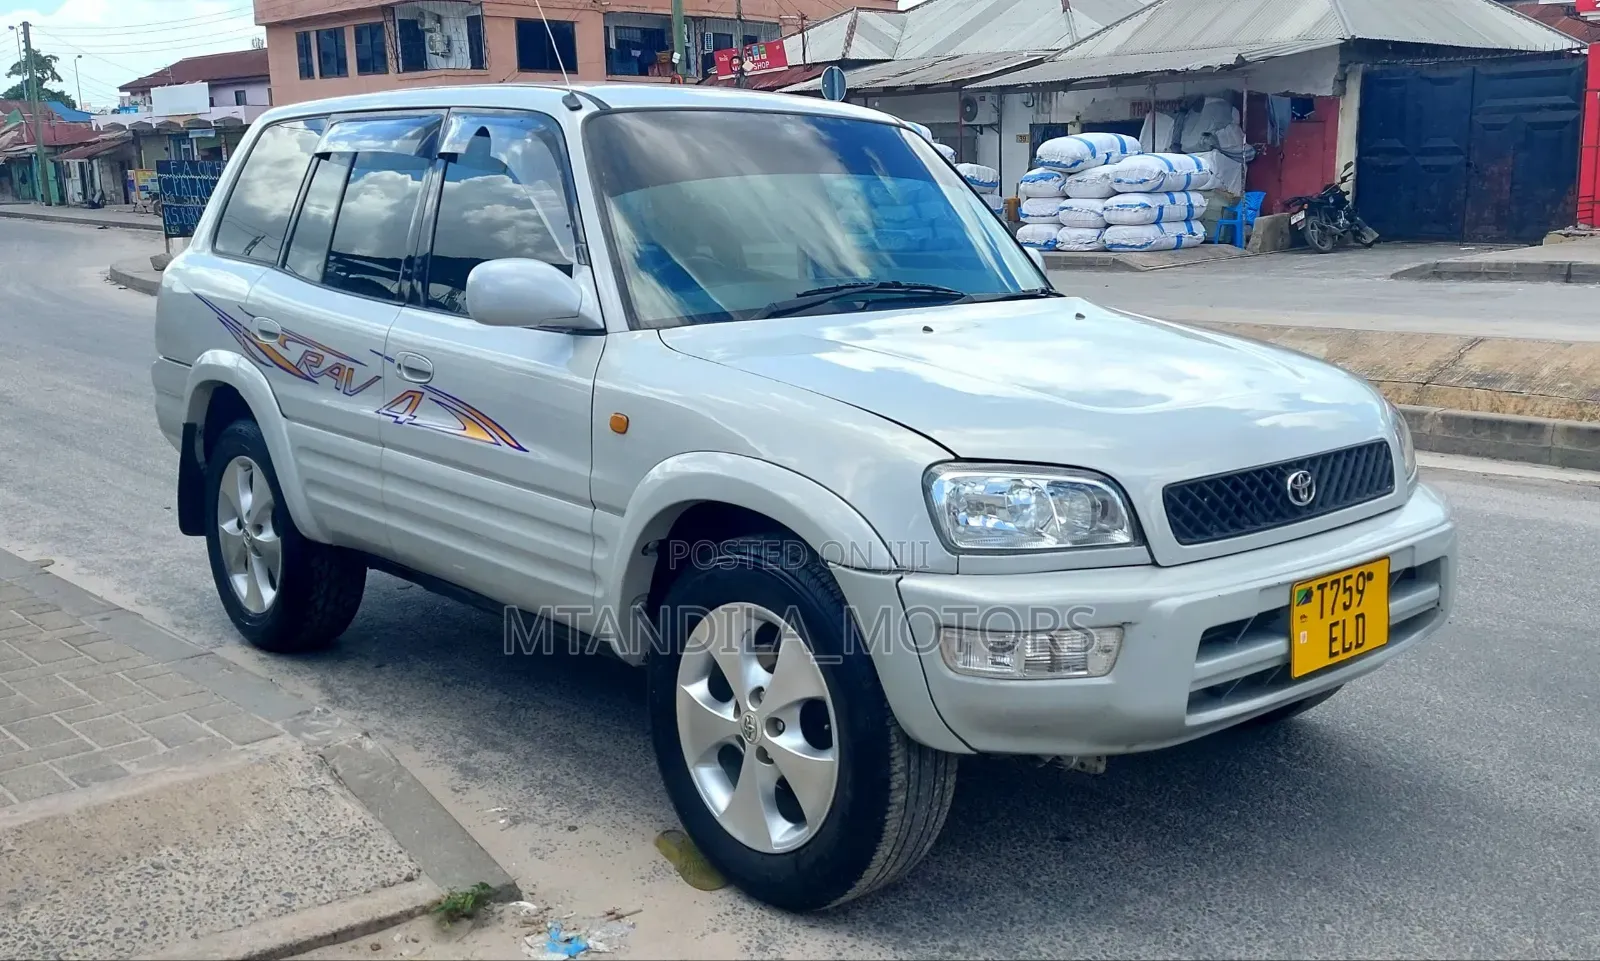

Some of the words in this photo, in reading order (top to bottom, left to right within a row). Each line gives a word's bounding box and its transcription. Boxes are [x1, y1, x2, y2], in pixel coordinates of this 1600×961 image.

[753, 61, 770, 70] SHOP
[296, 350, 382, 397] RAV
[375, 389, 425, 424] 4
[1317, 571, 1366, 620] T759
[1328, 612, 1366, 659] ELD
